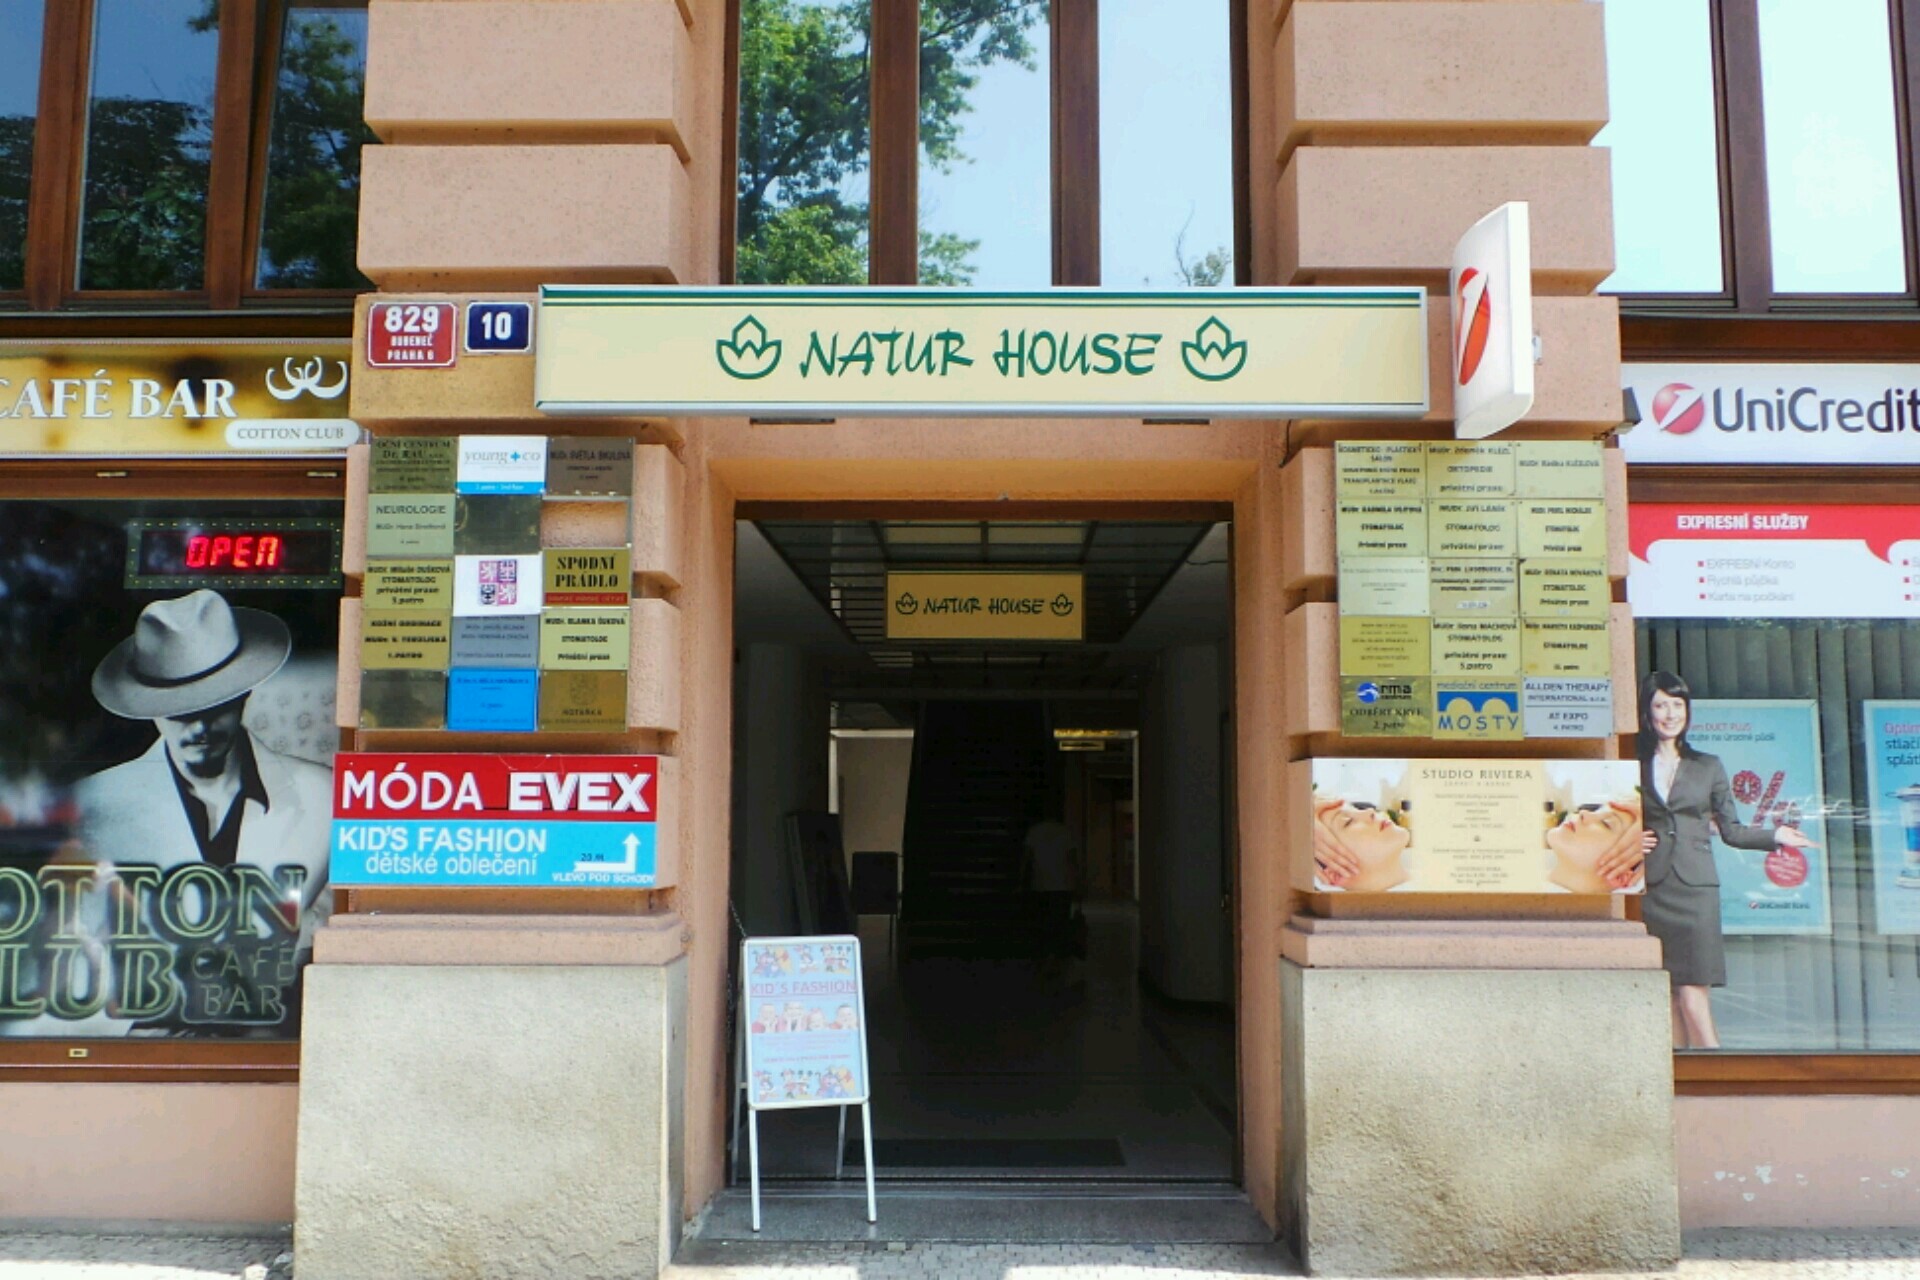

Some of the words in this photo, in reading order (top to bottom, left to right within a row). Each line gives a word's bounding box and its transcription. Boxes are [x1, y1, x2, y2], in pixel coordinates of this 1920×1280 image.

[384, 306, 439, 333] 829
[482, 312, 512, 340] 10
[387, 350, 425, 360] PRAHA
[427, 350, 435, 360] 6
[800, 327, 974, 378] NATUR
[993, 328, 1163, 378] HOUSE
[128, 378, 238, 418] BAR
[1713, 386, 1920, 432] UniCredit
[237, 427, 301, 439] COTTON
[304, 427, 344, 439] CLUB
[376, 505, 446, 514] NEUROLOGIE
[1677, 512, 1750, 530] EXPRESNÍ
[1752, 513, 1809, 530] SLUŽBY
[185, 536, 279, 568] OPEN
[557, 553, 615, 570] SPODNÍ
[555, 571, 618, 587] PRÁDLO
[923, 597, 982, 615] NATUR
[988, 598, 1045, 615] HOUSE
[1380, 684, 1412, 694] rma
[1478, 682, 1517, 690] centrum
[1565, 683, 1609, 691] THERAPY
[1438, 714, 1519, 731] MOSTY
[1422, 769, 1473, 779] STUDIO
[1480, 769, 1532, 779] RIVIERA
[342, 762, 484, 811] MÓDA
[508, 772, 651, 812] EVEX
[338, 826, 408, 850] KID'S
[417, 827, 548, 853] FASHION
[365, 851, 438, 874] dětské
[444, 852, 538, 876] oblečení
[552, 872, 585, 882] VLEVO
[588, 873, 610, 882] POD
[613, 873, 656, 883] SCHODY
[191, 940, 295, 982] CAFÉ
[793, 980, 857, 993] FASHION
[201, 983, 283, 1016] BAR
